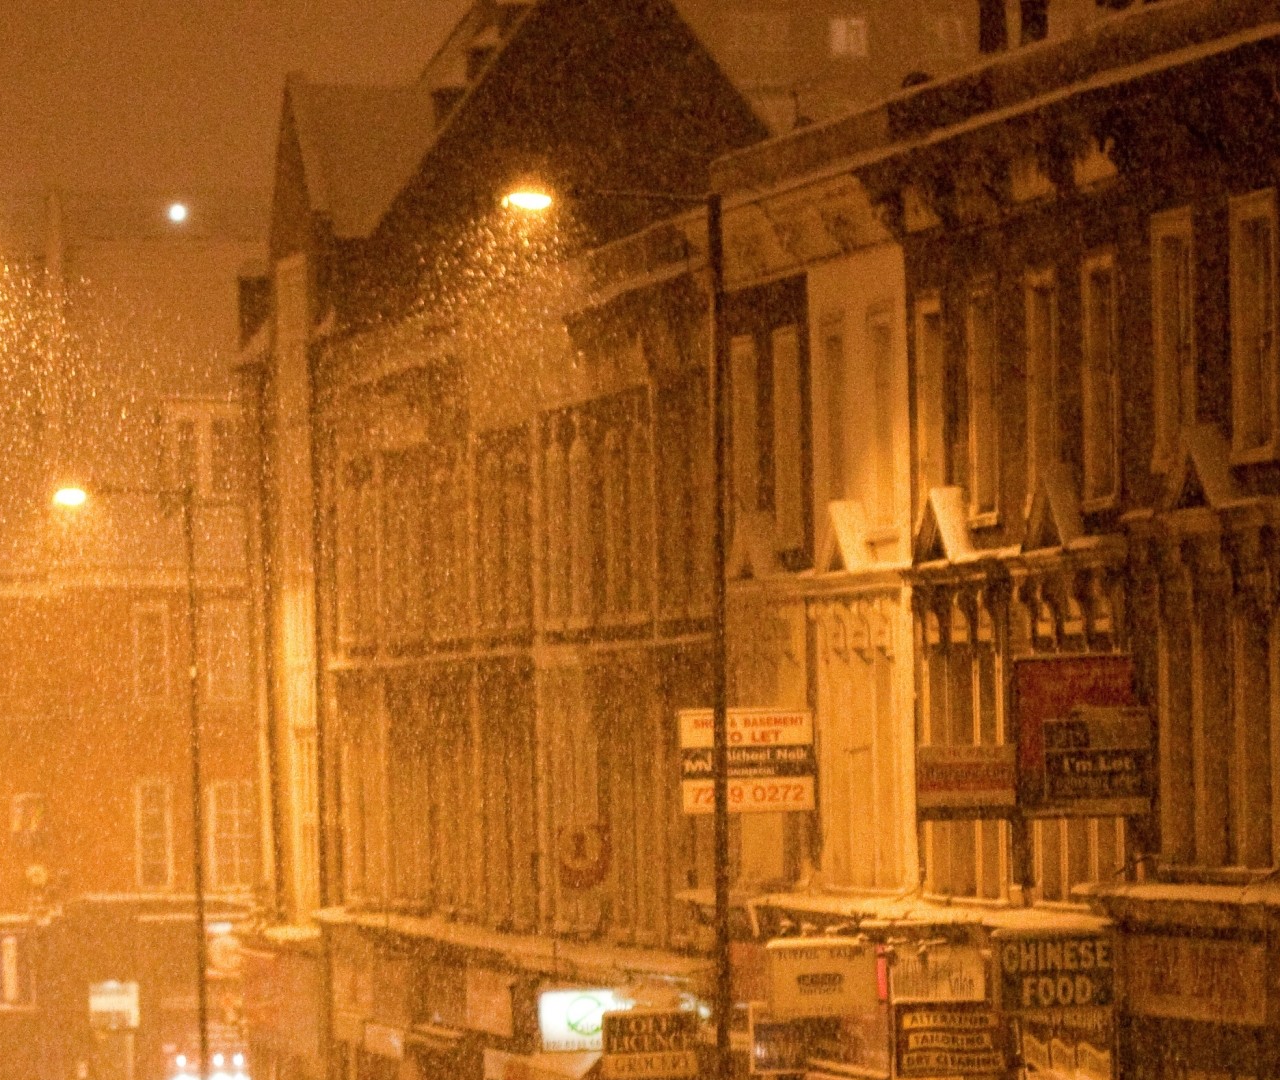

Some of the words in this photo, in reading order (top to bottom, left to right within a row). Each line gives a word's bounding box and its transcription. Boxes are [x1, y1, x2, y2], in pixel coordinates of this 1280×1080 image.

[693, 718, 716, 729] SHO
[743, 716, 804, 728] BASEMENT
[751, 730, 782, 743] LET
[692, 785, 744, 804] 729
[752, 784, 805, 804] 0272
[1003, 940, 1111, 973] CHINESE
[1022, 976, 1092, 1006] FOOD
